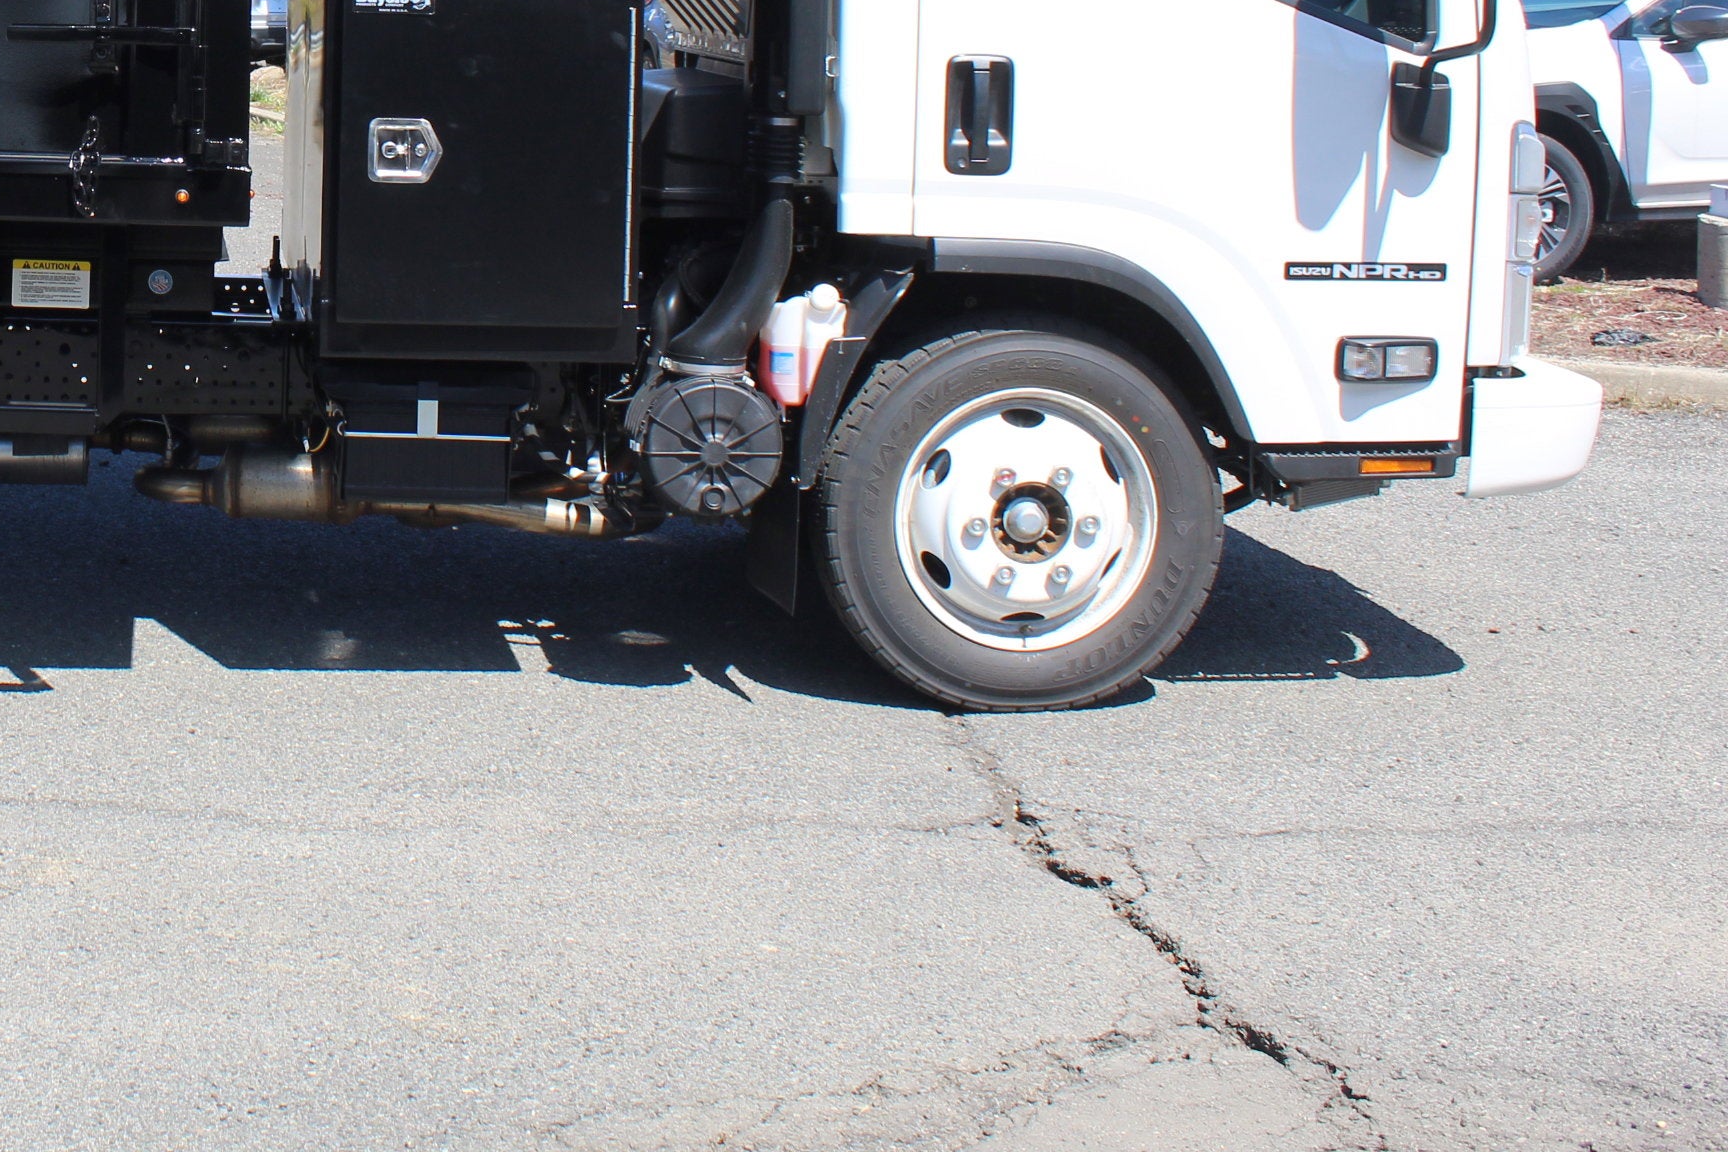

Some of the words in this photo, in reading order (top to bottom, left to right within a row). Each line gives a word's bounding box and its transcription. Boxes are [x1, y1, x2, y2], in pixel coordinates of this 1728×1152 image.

[33, 262, 70, 270] CAUTION
[1289, 266, 1331, 276] ISUZU
[1332, 263, 1408, 279] NPR
